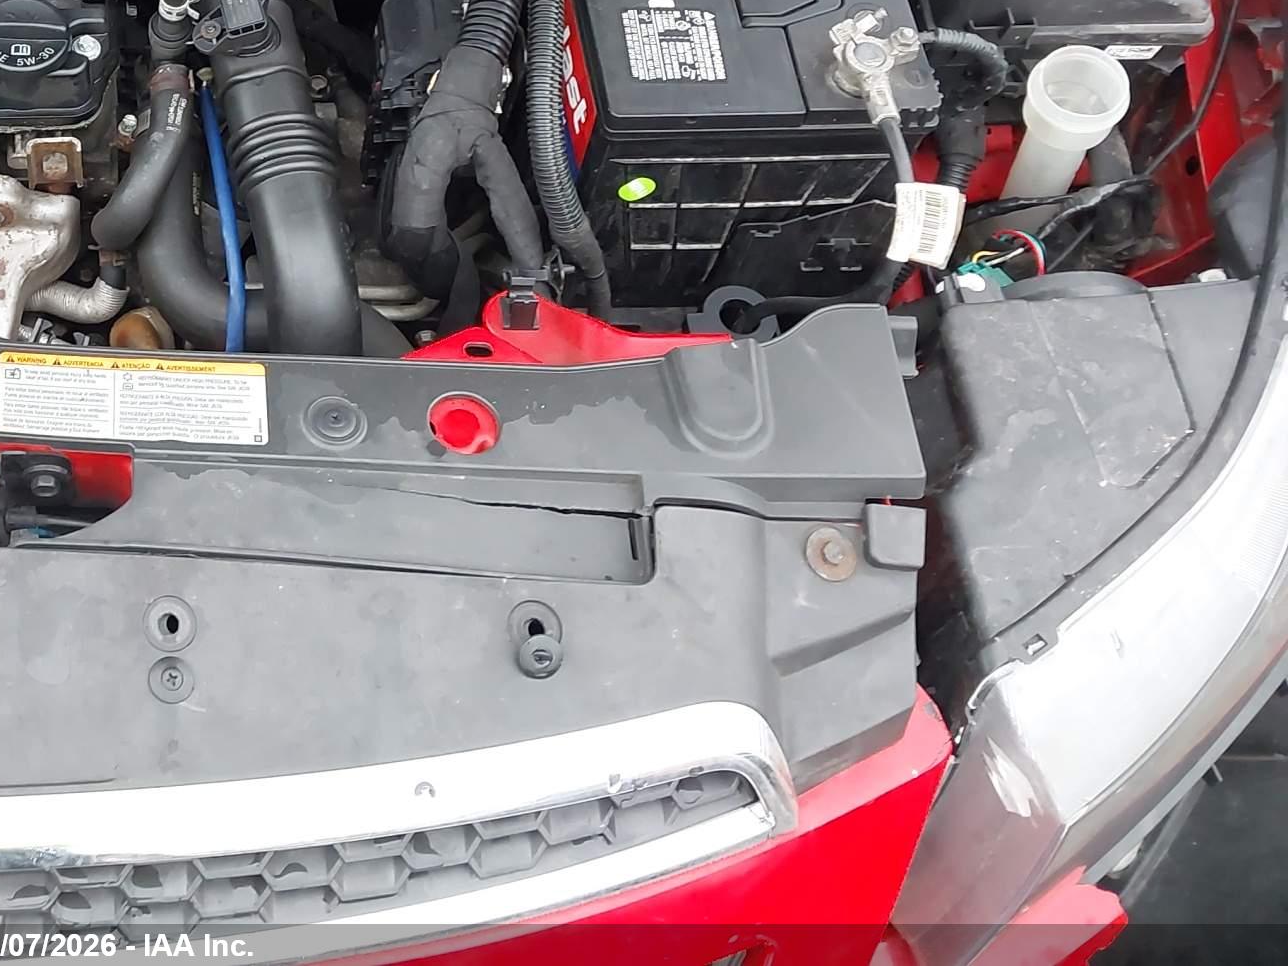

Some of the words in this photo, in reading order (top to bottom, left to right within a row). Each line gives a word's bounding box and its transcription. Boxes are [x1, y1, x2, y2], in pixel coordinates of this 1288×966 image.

[16, 47, 55, 67] 5W-30
[16, 356, 47, 364] WARNING
[63, 359, 104, 368] ADVERTENCIA
[121, 362, 151, 370] ATENÇÃO
